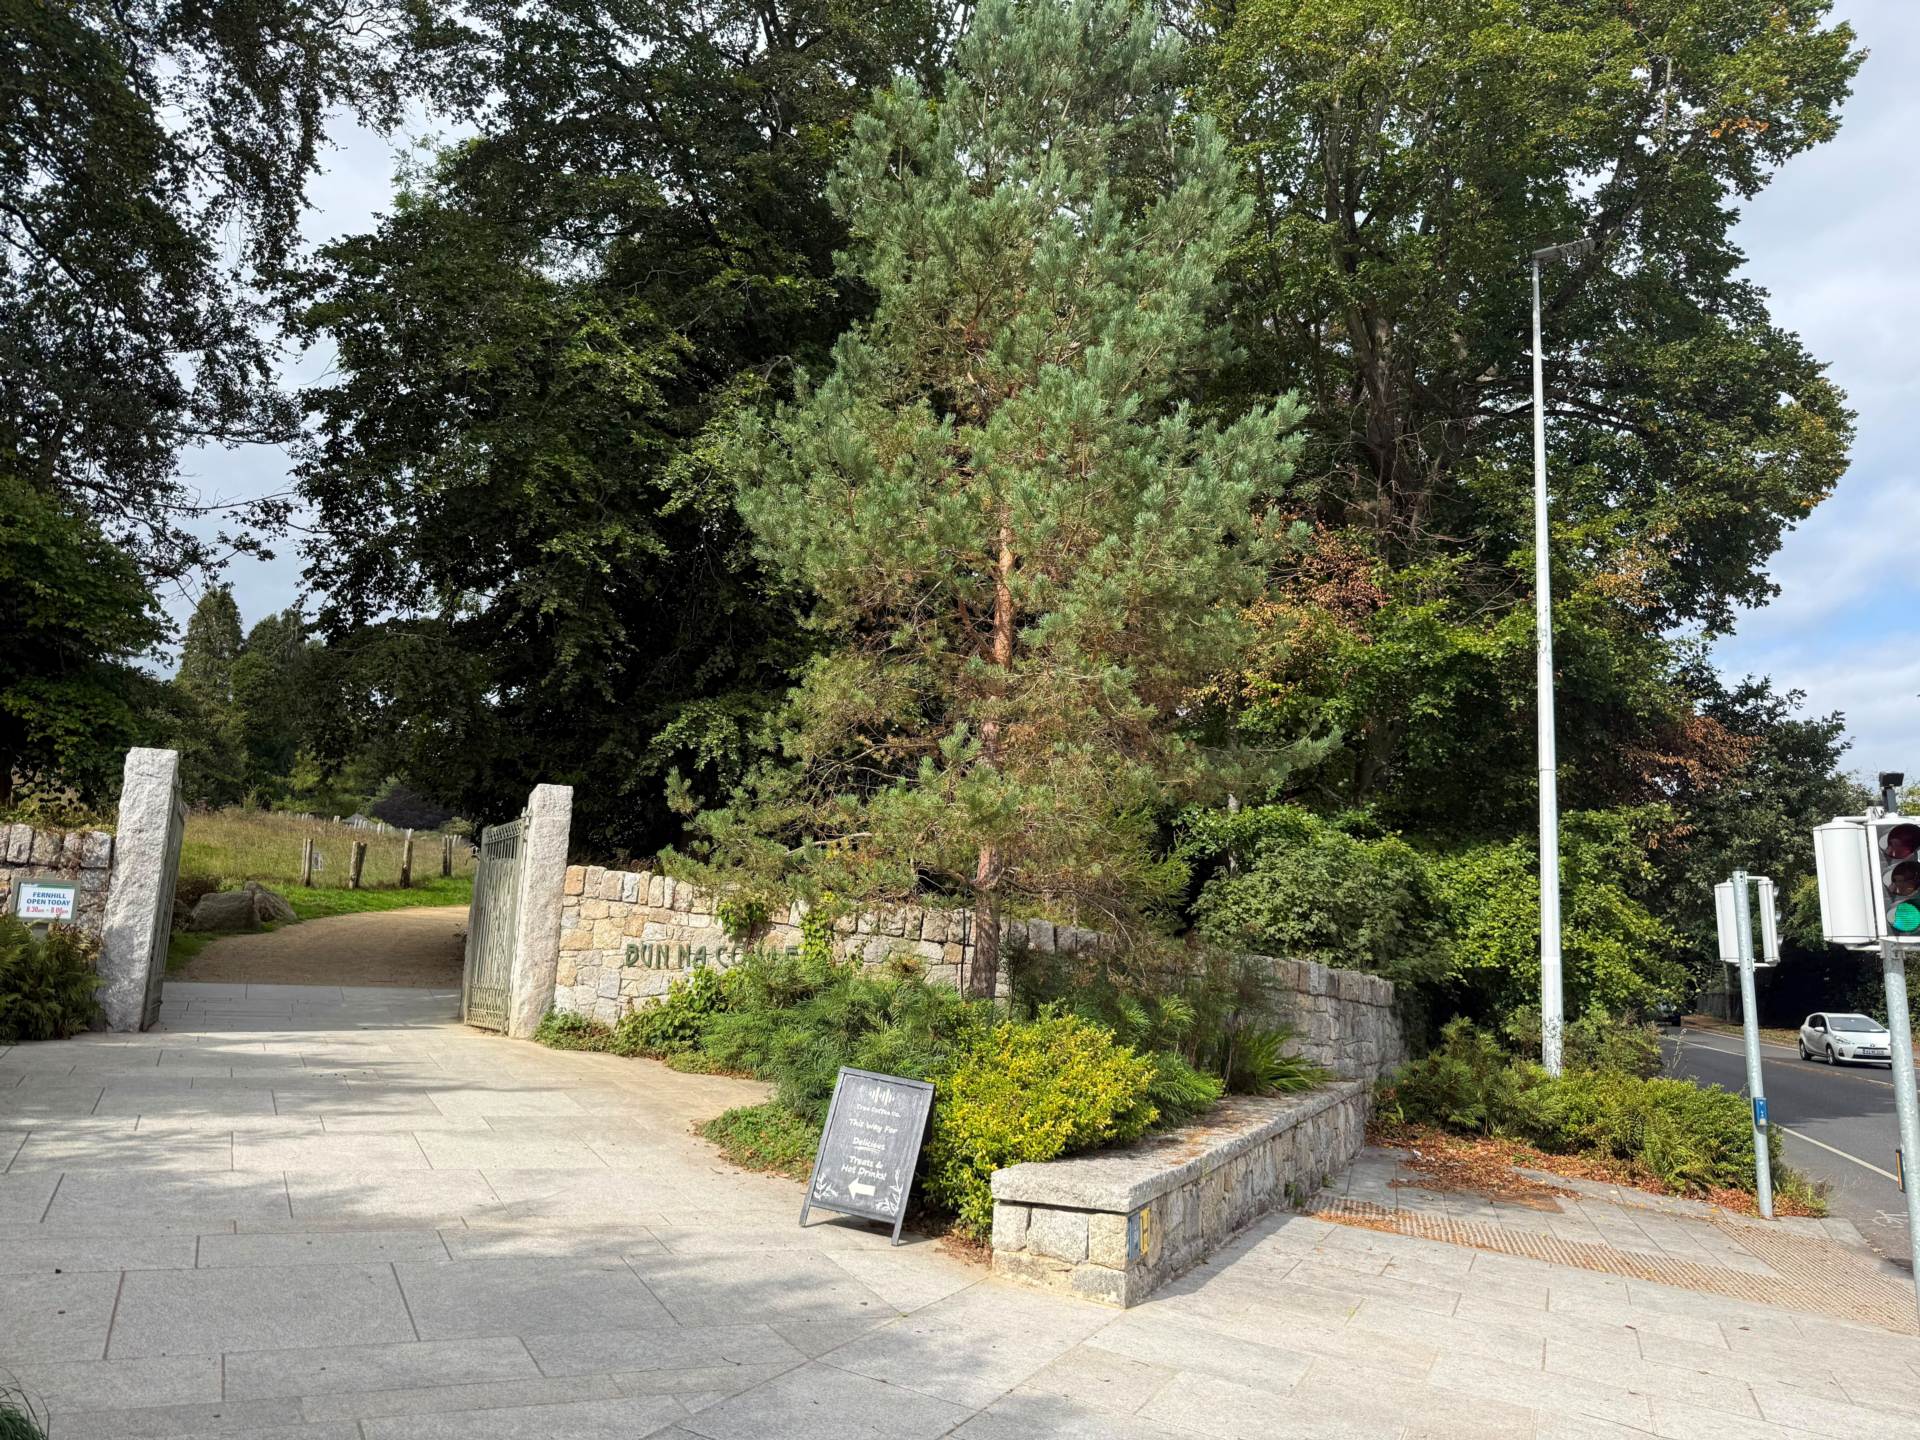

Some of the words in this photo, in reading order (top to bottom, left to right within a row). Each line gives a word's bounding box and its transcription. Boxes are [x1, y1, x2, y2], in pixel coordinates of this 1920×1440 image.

[849, 1118, 864, 1128] This
[866, 1121, 882, 1133] Way
[884, 1125, 898, 1134] For
[852, 1136, 886, 1150] Delicious
[849, 1155, 874, 1168] Treats
[841, 1163, 857, 1174] Hot
